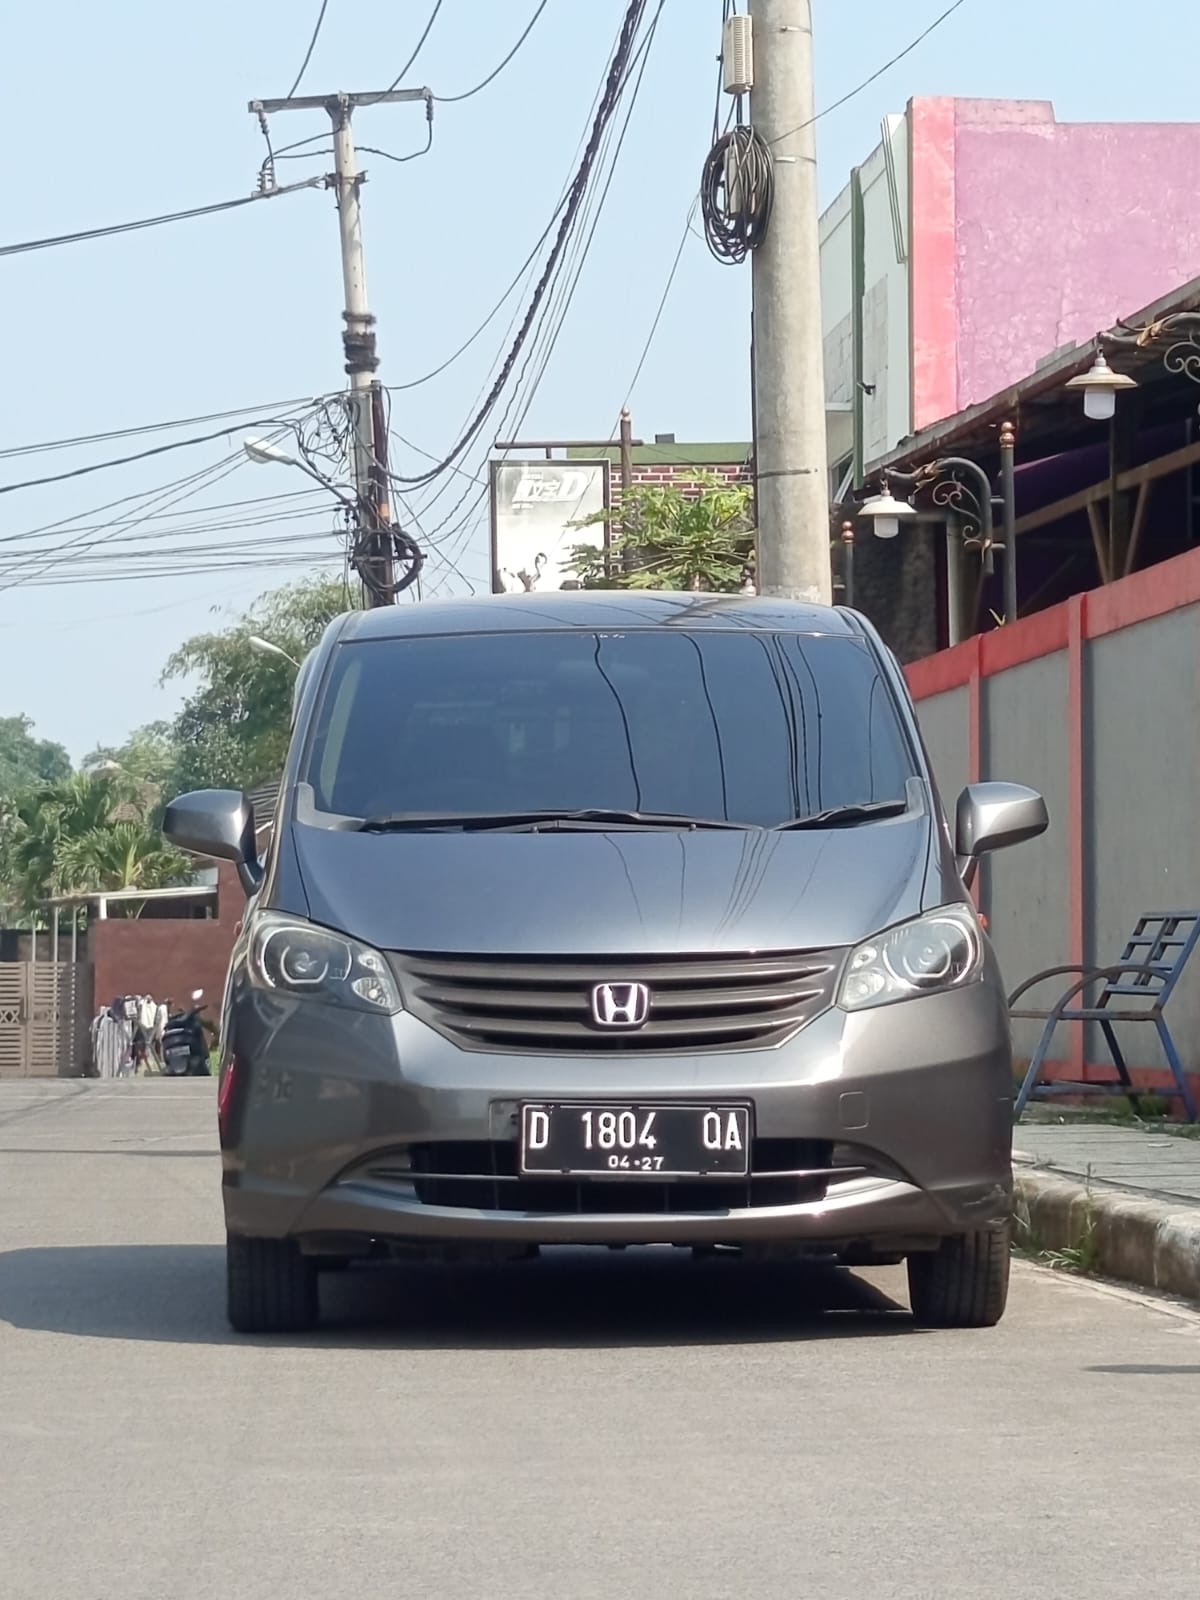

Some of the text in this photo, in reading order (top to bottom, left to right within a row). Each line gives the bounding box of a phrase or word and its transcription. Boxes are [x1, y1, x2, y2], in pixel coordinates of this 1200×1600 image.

[529, 1111, 743, 1150] D 1804 QA
